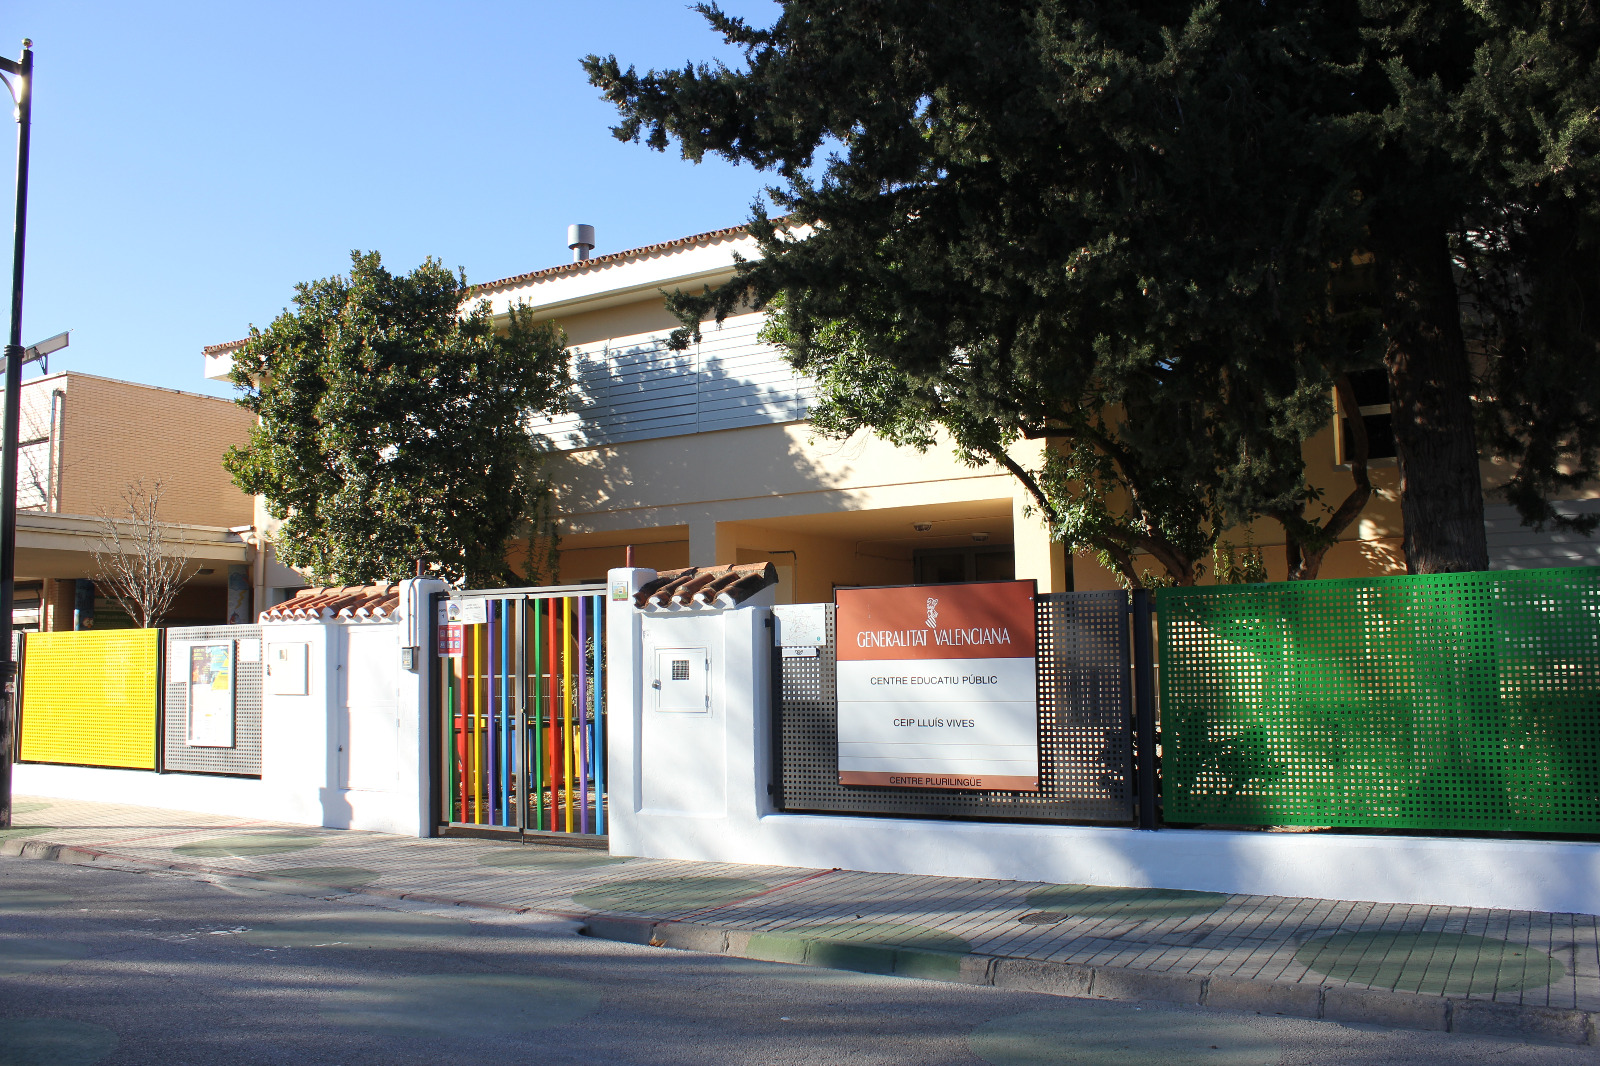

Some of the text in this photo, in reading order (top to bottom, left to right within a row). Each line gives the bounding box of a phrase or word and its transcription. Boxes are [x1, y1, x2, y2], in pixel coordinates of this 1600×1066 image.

[857, 627, 1011, 647] GENERALITAT VALENCIANA
[870, 673, 998, 686] CENTRE EDUCATIU PÚBLIC
[893, 717, 975, 728] CEIP LLUÍS VIVES
[889, 776, 982, 787] CENTRE PLURILINGÜE
